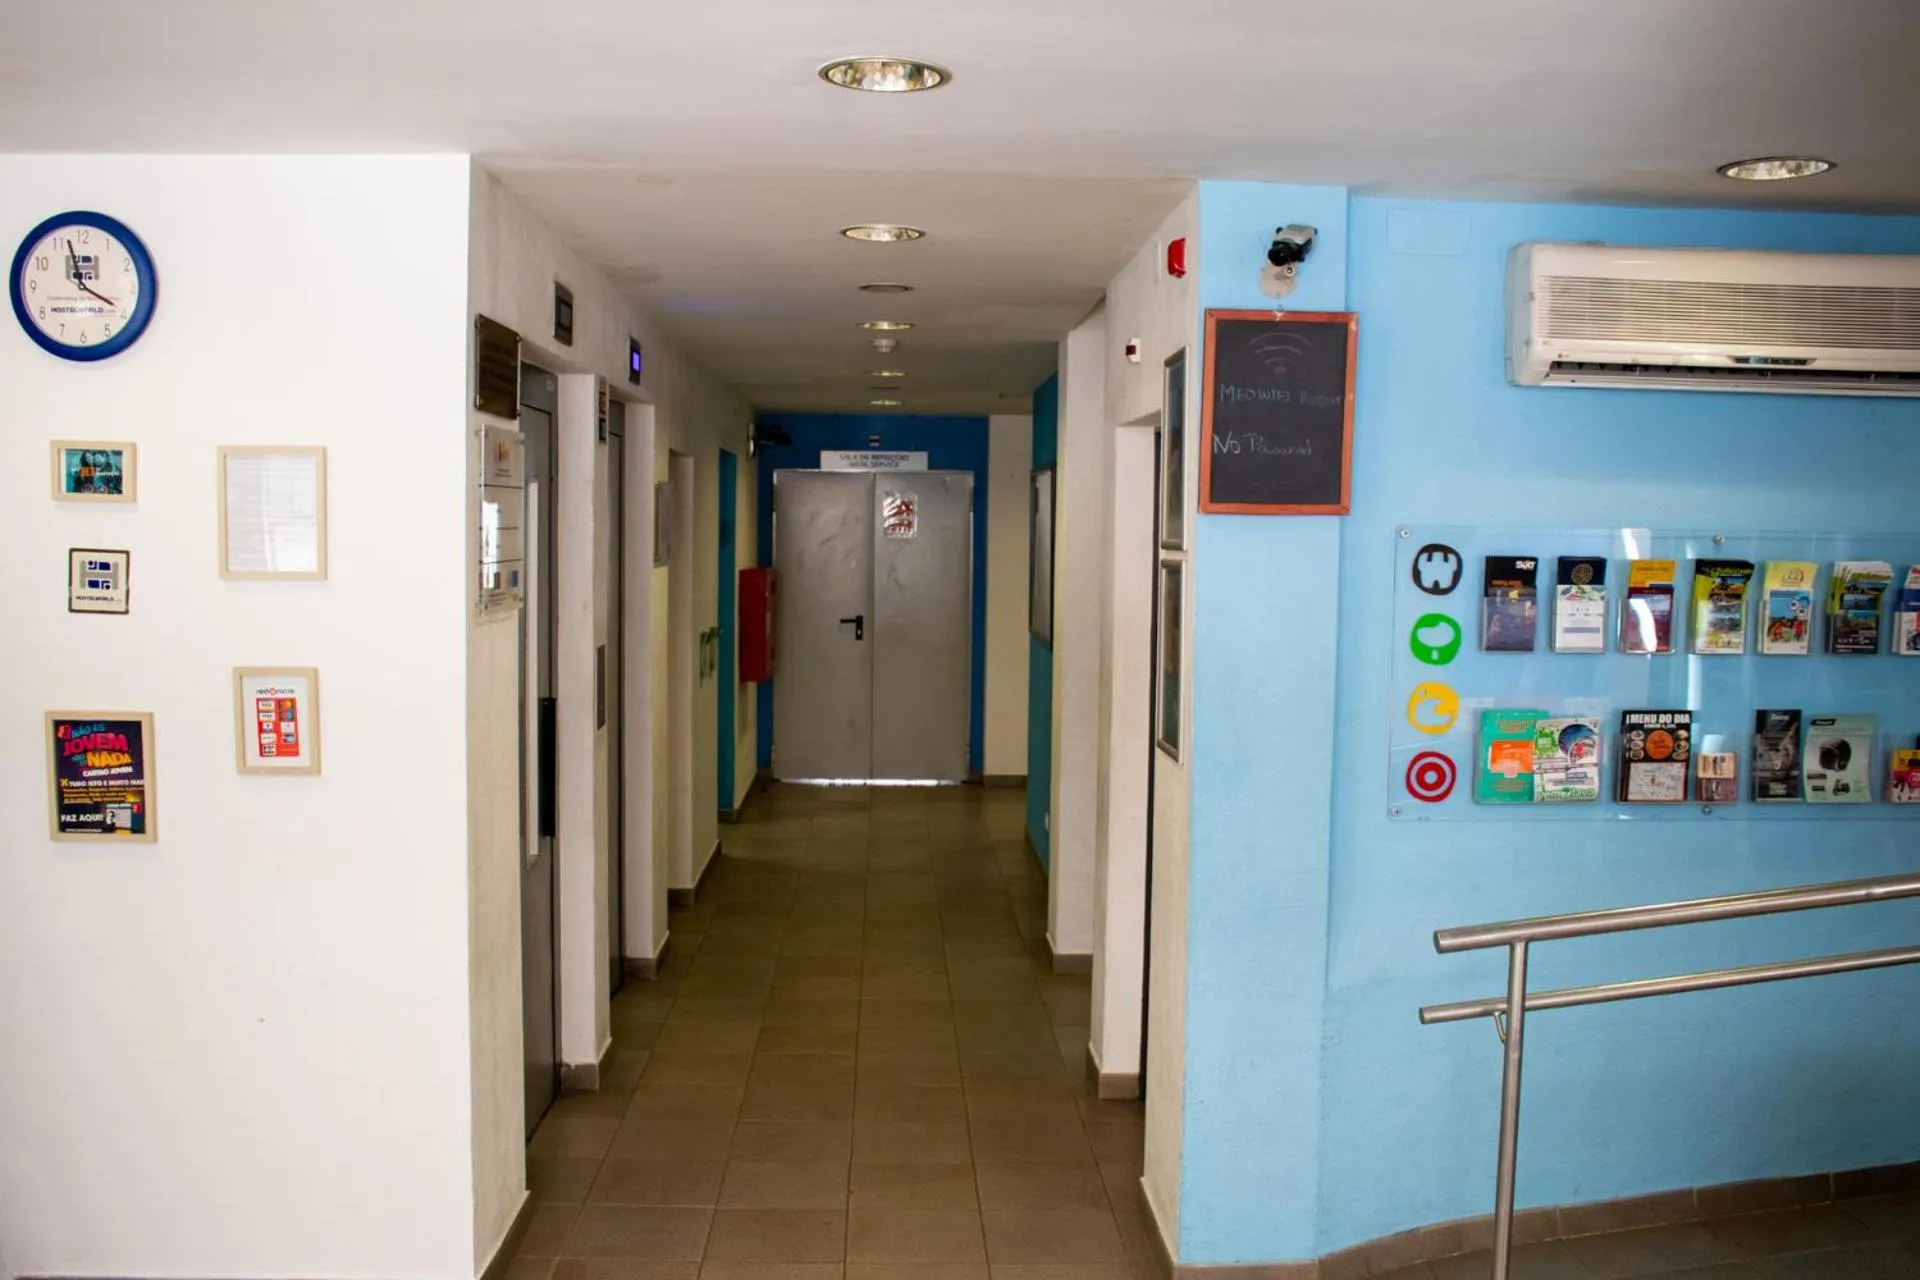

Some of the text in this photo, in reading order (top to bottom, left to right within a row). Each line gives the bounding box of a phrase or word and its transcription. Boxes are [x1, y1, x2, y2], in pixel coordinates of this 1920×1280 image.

[53, 237, 64, 250] 11
[77, 230, 90, 244] 12
[35, 257, 49, 271] 10
[124, 257, 130, 272] 2
[30, 281, 37, 292] 9
[39, 306, 46, 320] 8
[59, 324, 66, 337] 7
[80, 330, 87, 343] 6
[104, 324, 111, 337] 5
[1212, 431, 1241, 454] No
[1630, 713, 1691, 724] MENU DO DIA
[63, 732, 129, 756] JOVEM
[86, 751, 132, 767] NADA
